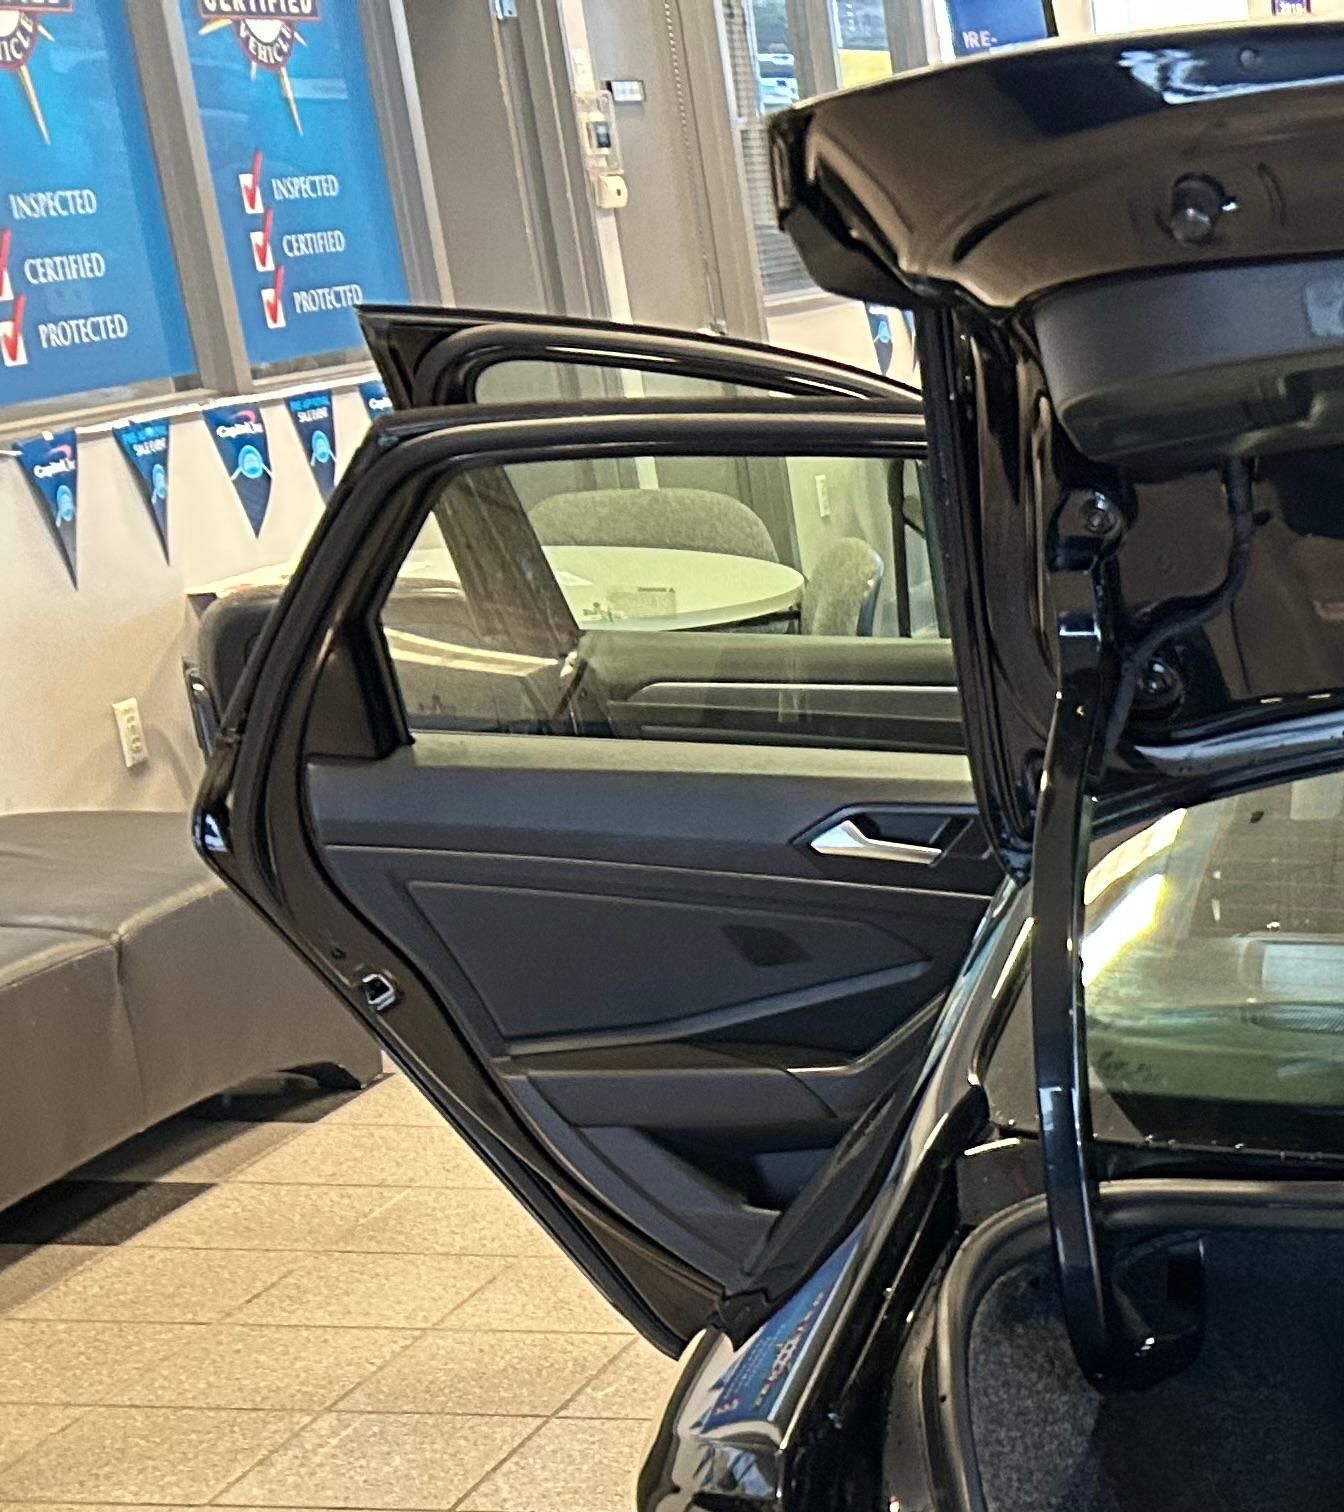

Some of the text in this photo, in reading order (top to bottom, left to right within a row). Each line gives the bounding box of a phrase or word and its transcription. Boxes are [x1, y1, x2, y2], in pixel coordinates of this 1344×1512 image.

[271, 174, 340, 201] INSPECTED
[9, 188, 97, 220] INSPECTED
[282, 229, 346, 257] CERTIFIED
[24, 252, 106, 285] CERTIFIED
[293, 284, 364, 314] PROTECTED
[38, 313, 128, 349] PROTECTED
